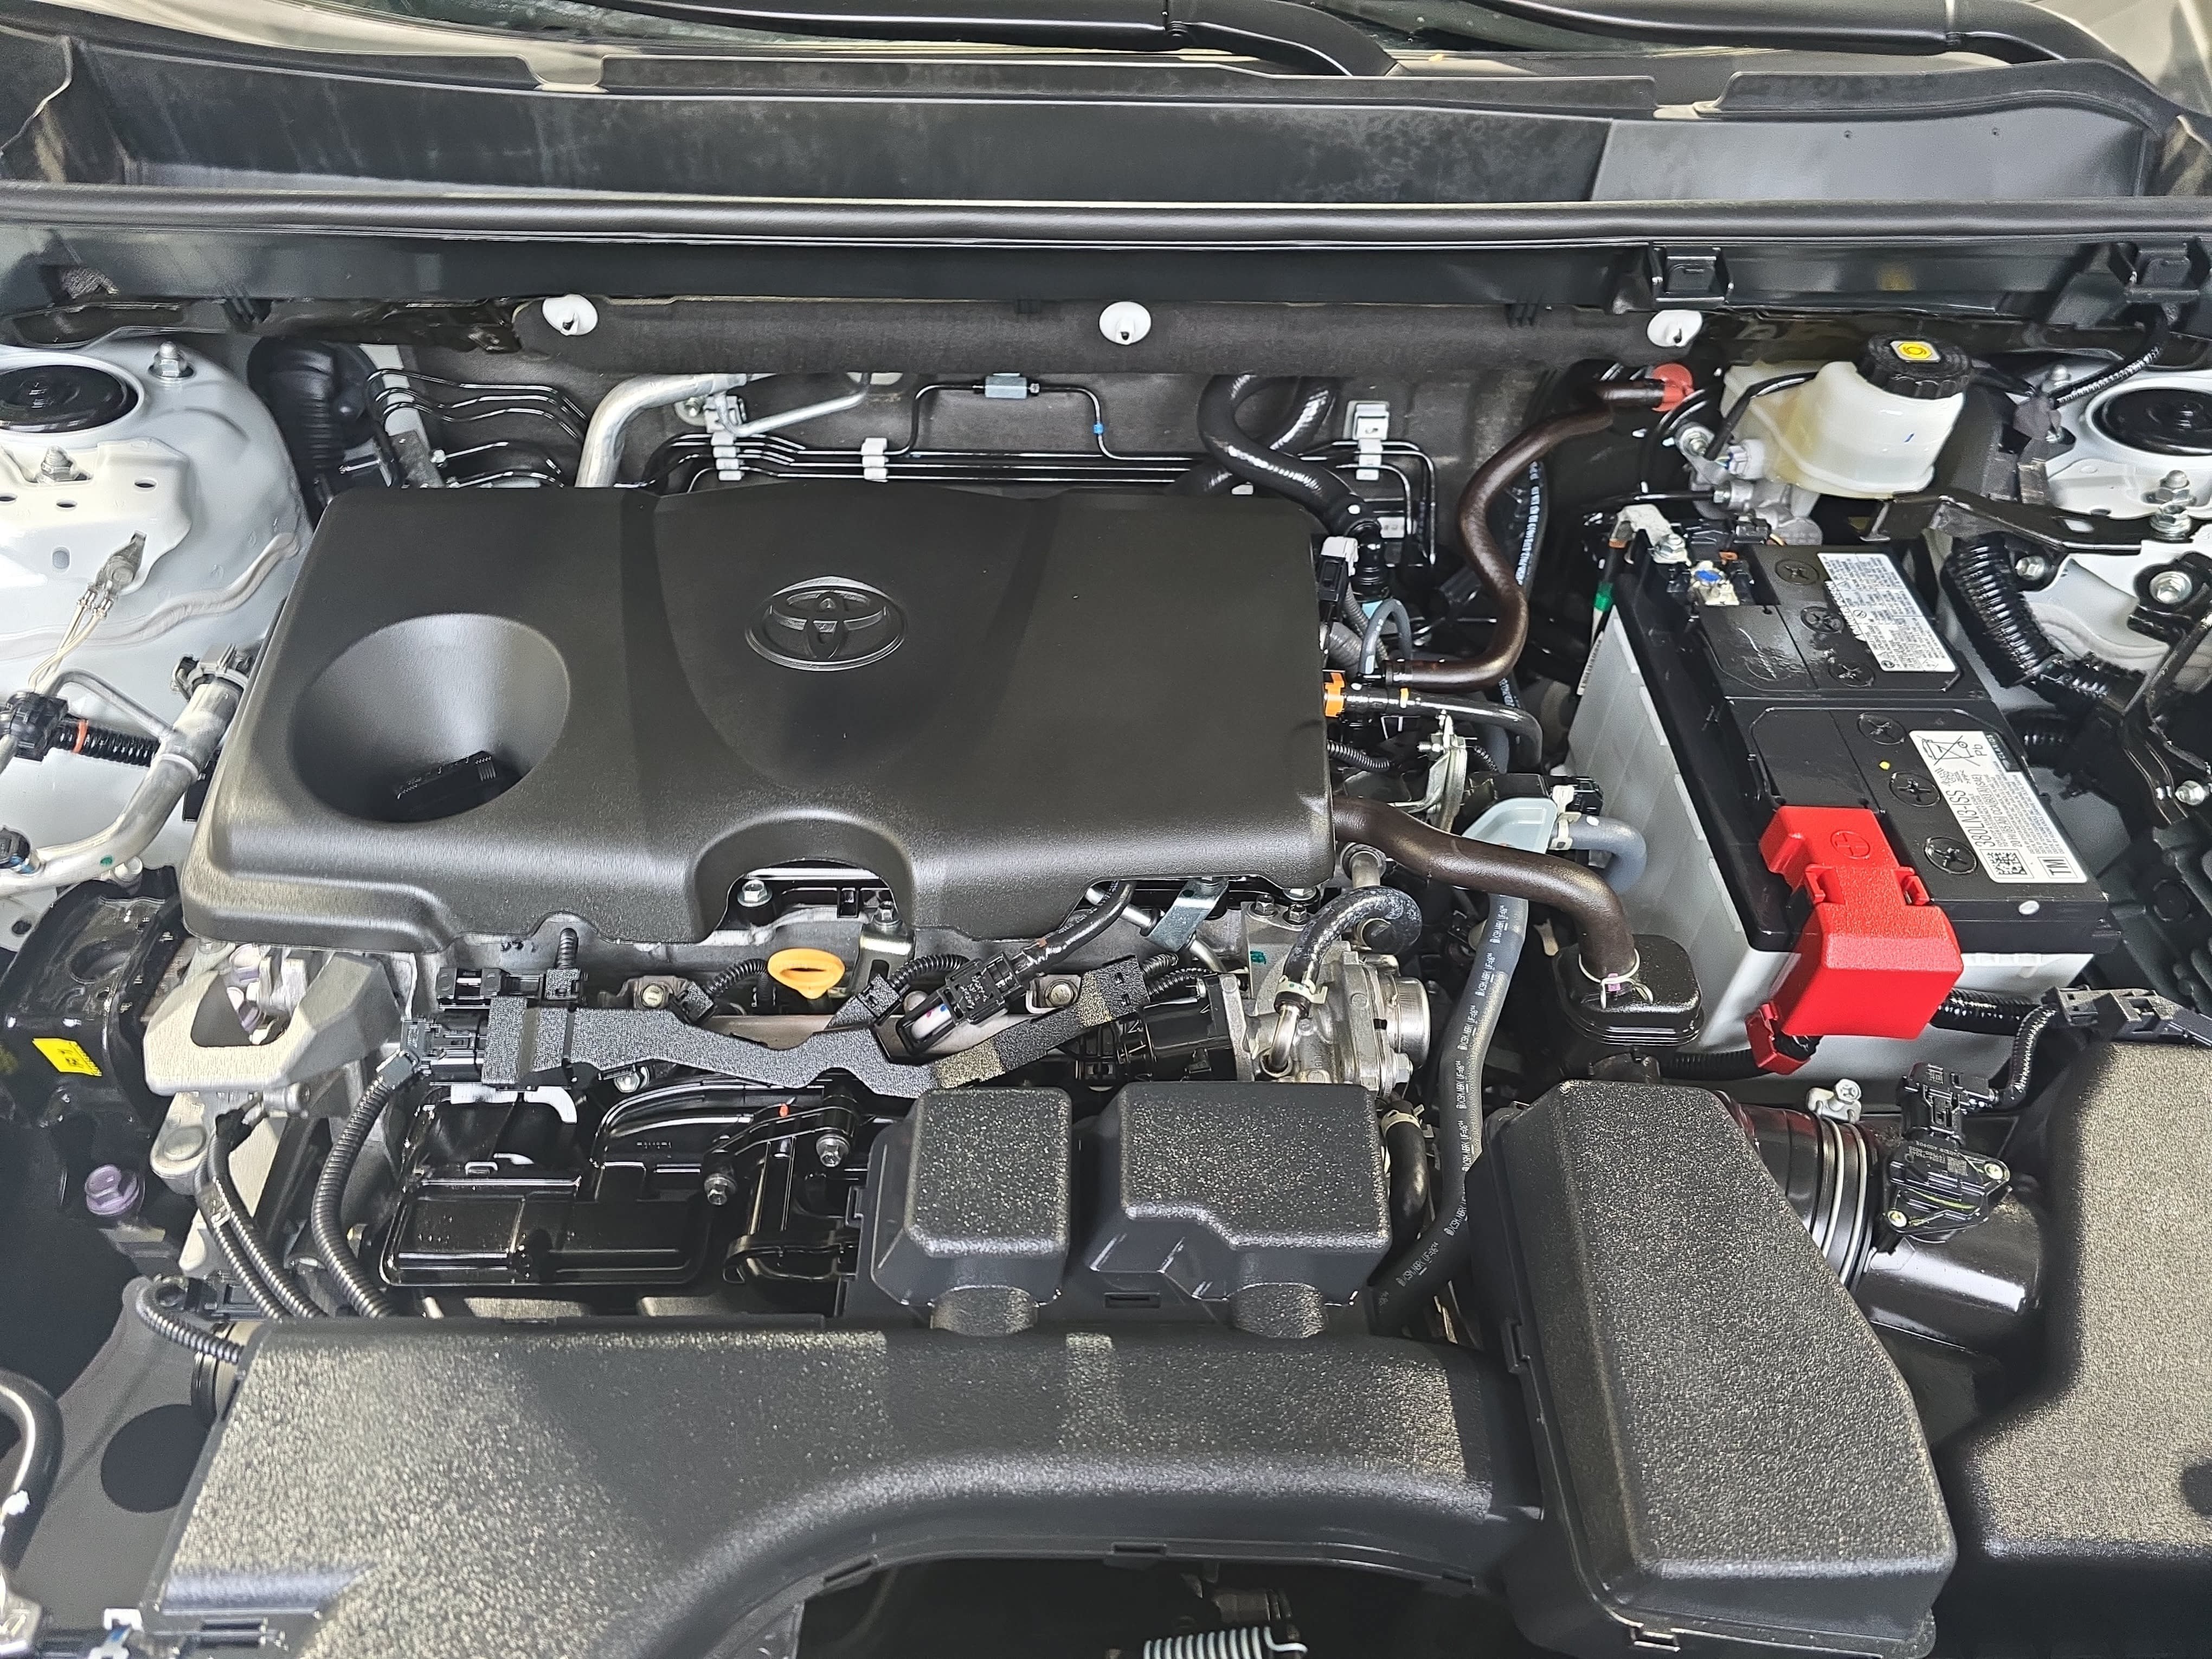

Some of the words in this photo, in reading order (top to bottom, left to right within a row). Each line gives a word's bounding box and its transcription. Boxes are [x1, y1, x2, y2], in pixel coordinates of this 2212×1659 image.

[1969, 744, 1988, 756] Pb
[1985, 734, 2007, 759] CLARIOS
[1969, 774, 1989, 787] (SAE)
[1987, 804, 2004, 815] CCA
[1944, 790, 1997, 847] 380LN3-ISS
[2042, 859, 2073, 875] TM
